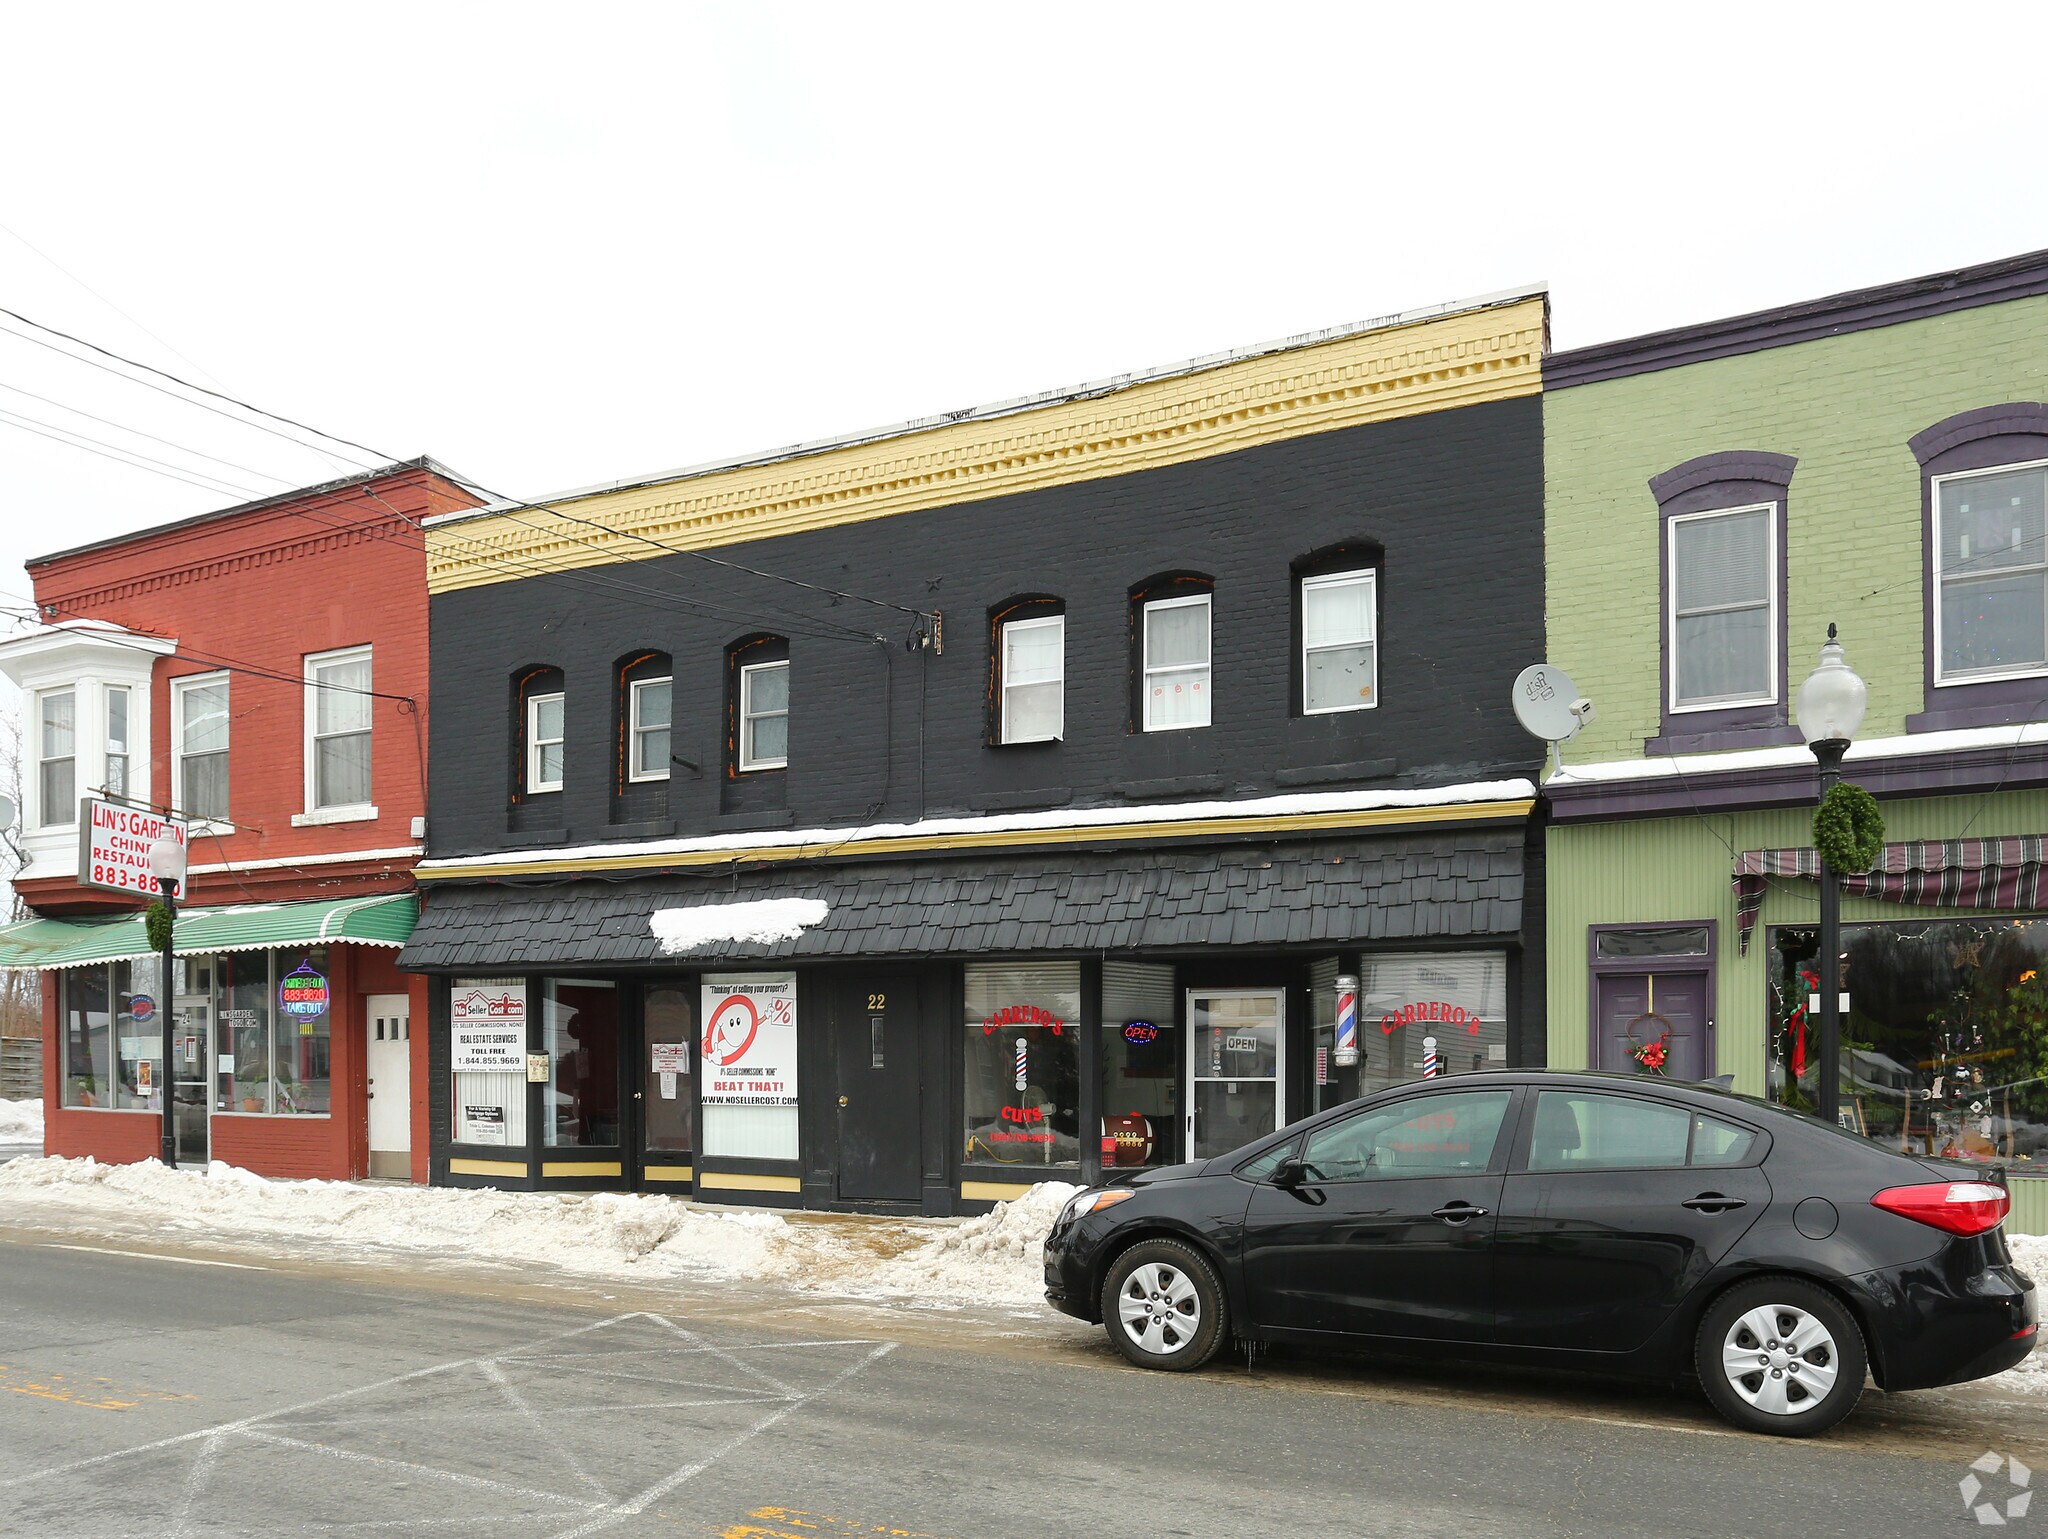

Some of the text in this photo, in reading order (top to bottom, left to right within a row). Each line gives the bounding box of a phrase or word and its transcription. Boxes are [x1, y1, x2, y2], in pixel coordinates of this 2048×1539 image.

[93, 804, 184, 845] LIN'S GARN
[94, 865, 180, 897] 883-880
[867, 994, 885, 1010] 22
[468, 1004, 487, 1015] Seller
[182, 1014, 191, 1025] 24
[983, 1005, 1064, 1036] CARRERO'S
[1380, 1001, 1481, 1035] CARRERO'S
[460, 1034, 518, 1044] REAL ESTATE SERVICES
[1125, 1027, 1158, 1040] OPEN
[1228, 1037, 1255, 1050] OPEN
[714, 1082, 784, 1092] BEAT THAT!
[701, 1096, 798, 1105] WWW.NOSELLERCOST.COM
[1001, 1105, 1043, 1123] CUTS
